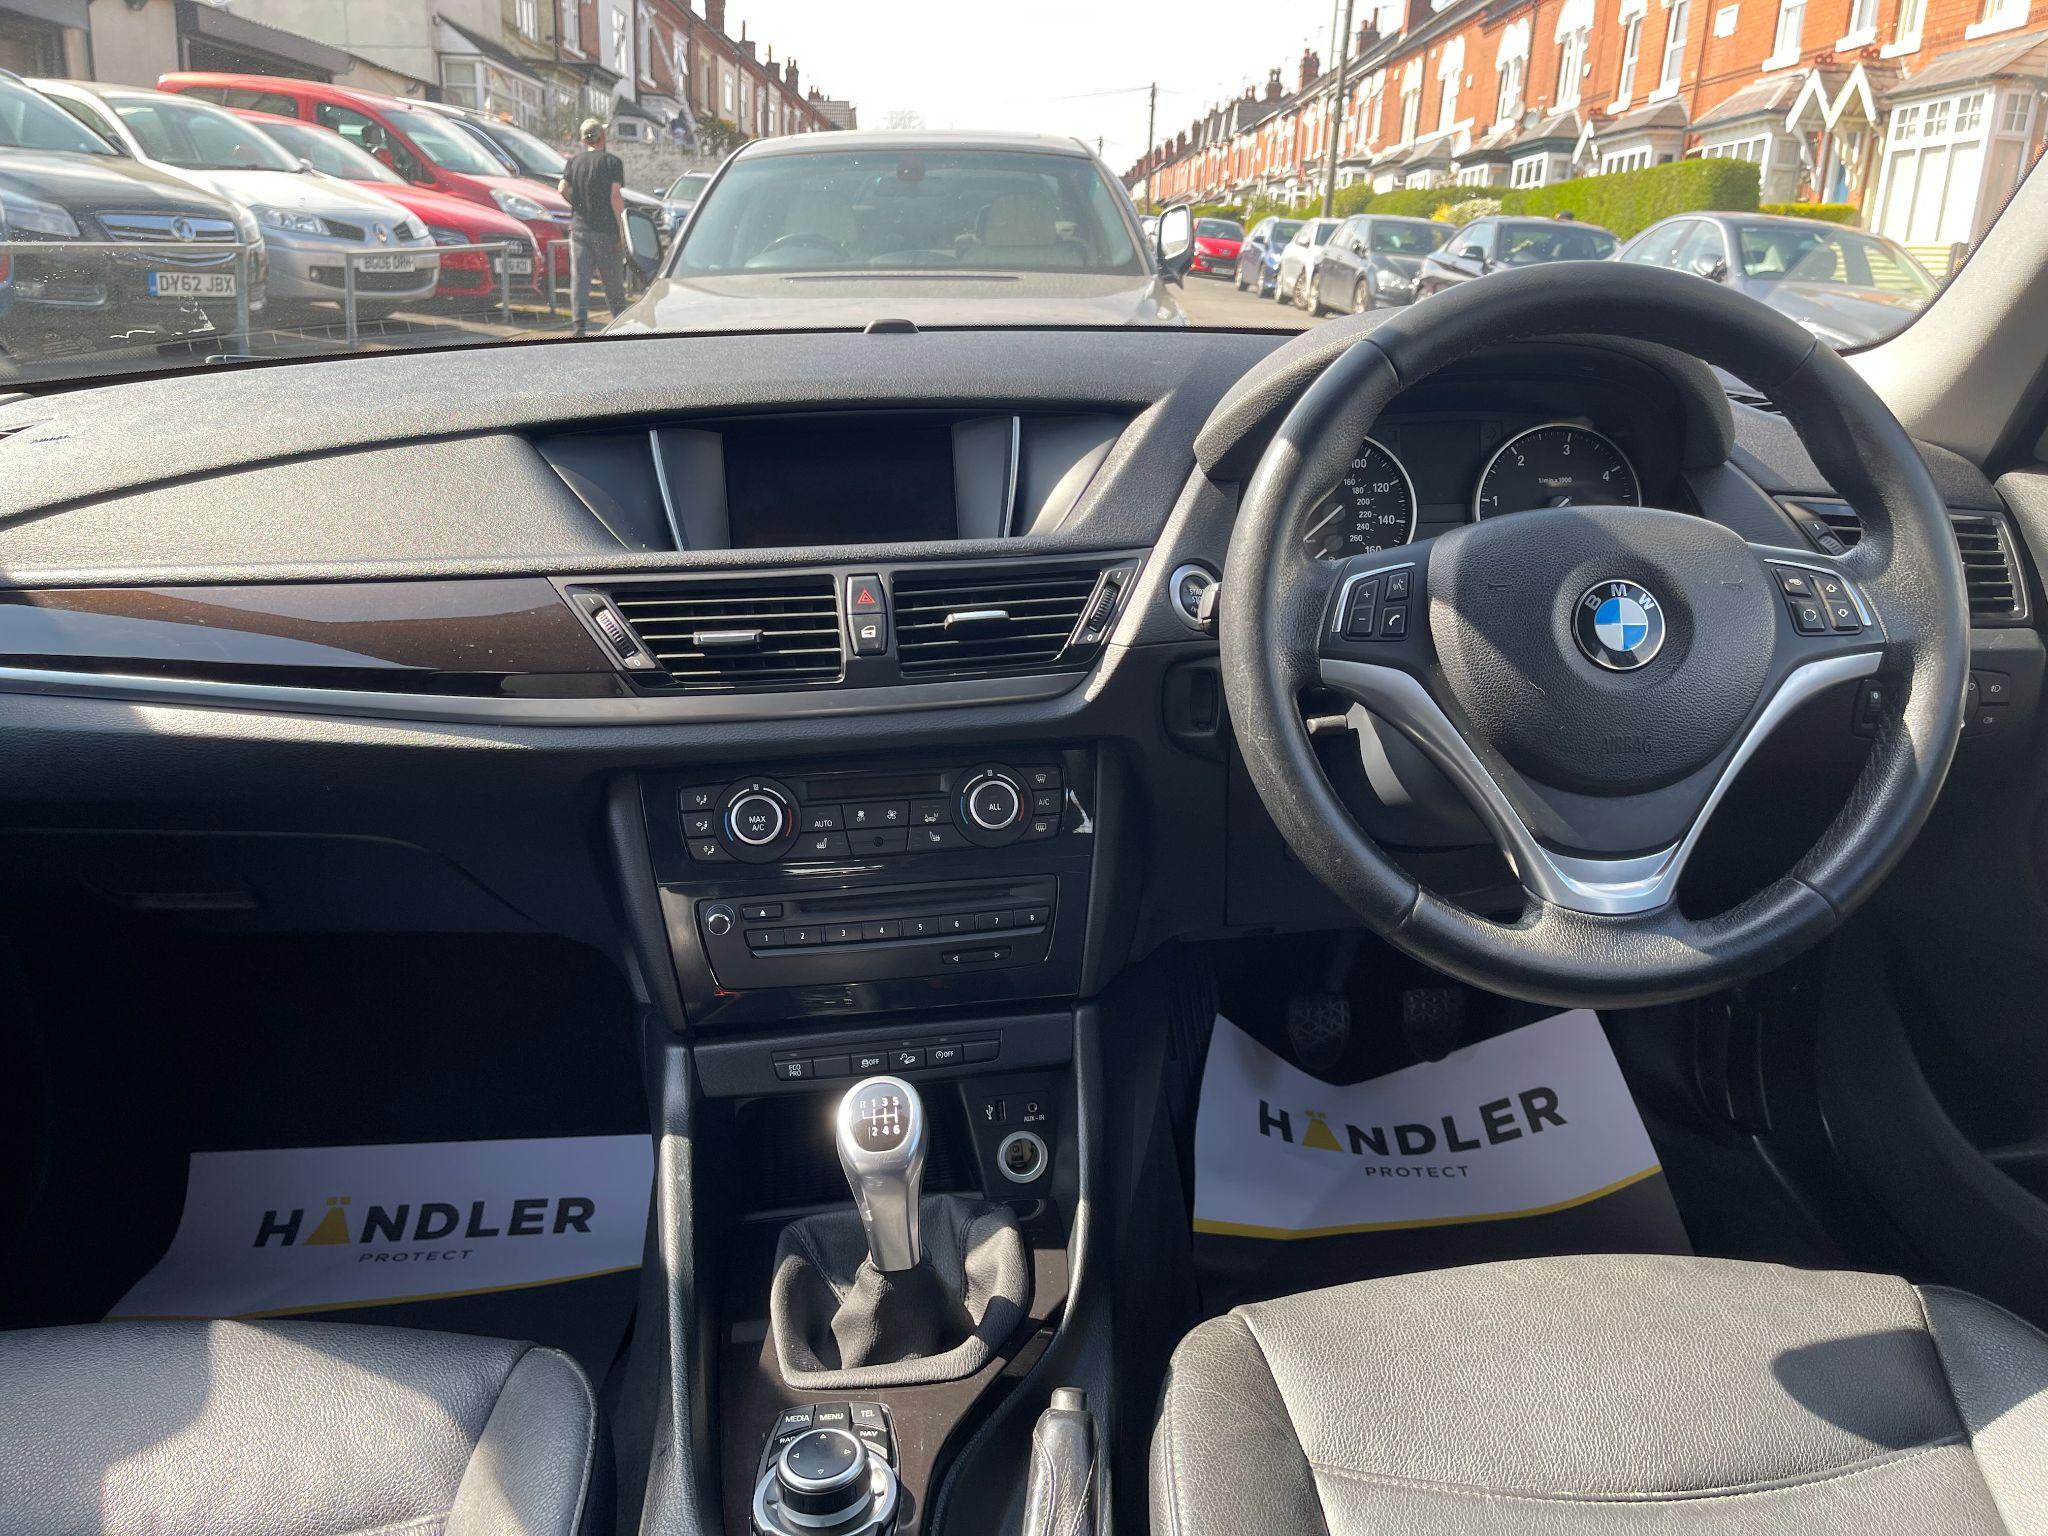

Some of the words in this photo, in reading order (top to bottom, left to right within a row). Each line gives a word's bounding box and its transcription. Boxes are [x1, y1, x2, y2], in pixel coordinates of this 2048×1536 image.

[159, 275, 202, 292] DY62
[206, 276, 233, 293] JBX
[1563, 444, 1571, 456] 3
[1351, 458, 1367, 469] 100
[1517, 455, 1525, 466] 2
[1602, 470, 1610, 481] 4
[1343, 478, 1356, 486] 160
[1351, 486, 1364, 495] 180
[1372, 482, 1390, 493] 120
[1356, 498, 1370, 506] 200
[1492, 495, 1498, 507] 1
[1358, 510, 1372, 519] 220
[1377, 514, 1396, 526] 140
[1356, 523, 1370, 531] 240
[1349, 534, 1363, 543] 260
[1584, 583, 1655, 612] BMW
[1038, 798, 1051, 807] A/C
[988, 803, 1002, 812] ALL
[748, 815, 766, 824] MAX
[814, 819, 833, 829] AUTO
[751, 823, 765, 832] A/C
[954, 920, 960, 928] 6
[994, 917, 999, 925] 7
[879, 927, 885, 935] 4
[918, 923, 923, 931] 5
[800, 932, 805, 940] 2
[841, 929, 846, 937] 3
[764, 934, 769, 942] 1
[943, 1050, 954, 1059] OFF
[869, 1058, 880, 1066] OFF
[859, 1100, 866, 1108] R
[871, 1098, 876, 1107] 1
[881, 1097, 888, 1107] 3
[892, 1096, 899, 1106] 5
[1258, 1086, 1568, 1156] HÄNDLER
[871, 1126, 878, 1136] 2
[881, 1125, 889, 1135] 4
[892, 1124, 900, 1134] 6
[1364, 1165, 1469, 1178] PROTECT
[252, 1196, 596, 1248] HÄNDLER
[359, 1250, 473, 1263] PROTECT
[819, 1413, 844, 1421] MENU
[861, 1409, 875, 1418] TEL
[785, 1414, 810, 1423] MEDIA
